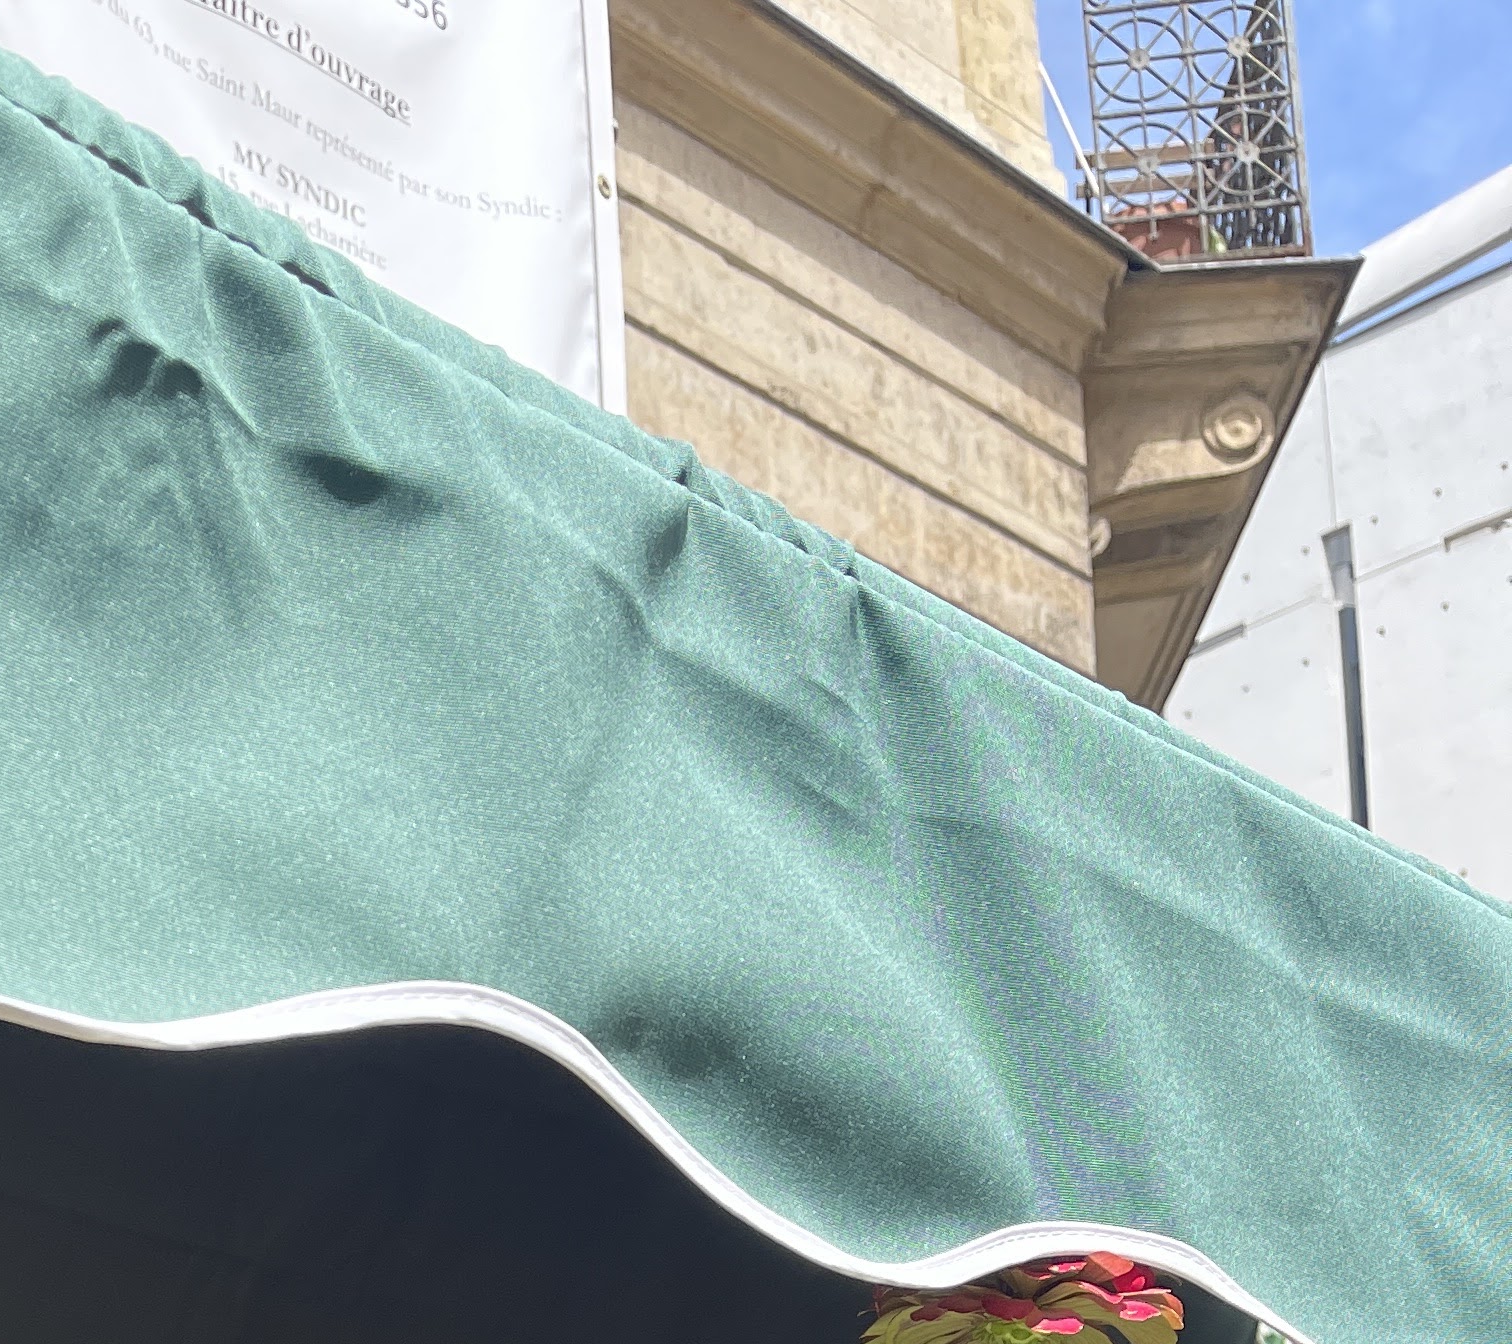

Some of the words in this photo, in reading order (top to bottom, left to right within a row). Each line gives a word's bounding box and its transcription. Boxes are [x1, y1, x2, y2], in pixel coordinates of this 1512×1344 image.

[162, 43, 192, 73] rue
[195, 57, 247, 100] Saint
[251, 81, 303, 129] Maur
[305, 120, 395, 183] représenté
[398, 171, 430, 196] par
[434, 186, 472, 210] son
[476, 190, 551, 222] Syndic
[233, 139, 272, 178] MY
[276, 162, 368, 229] SYNDIC
